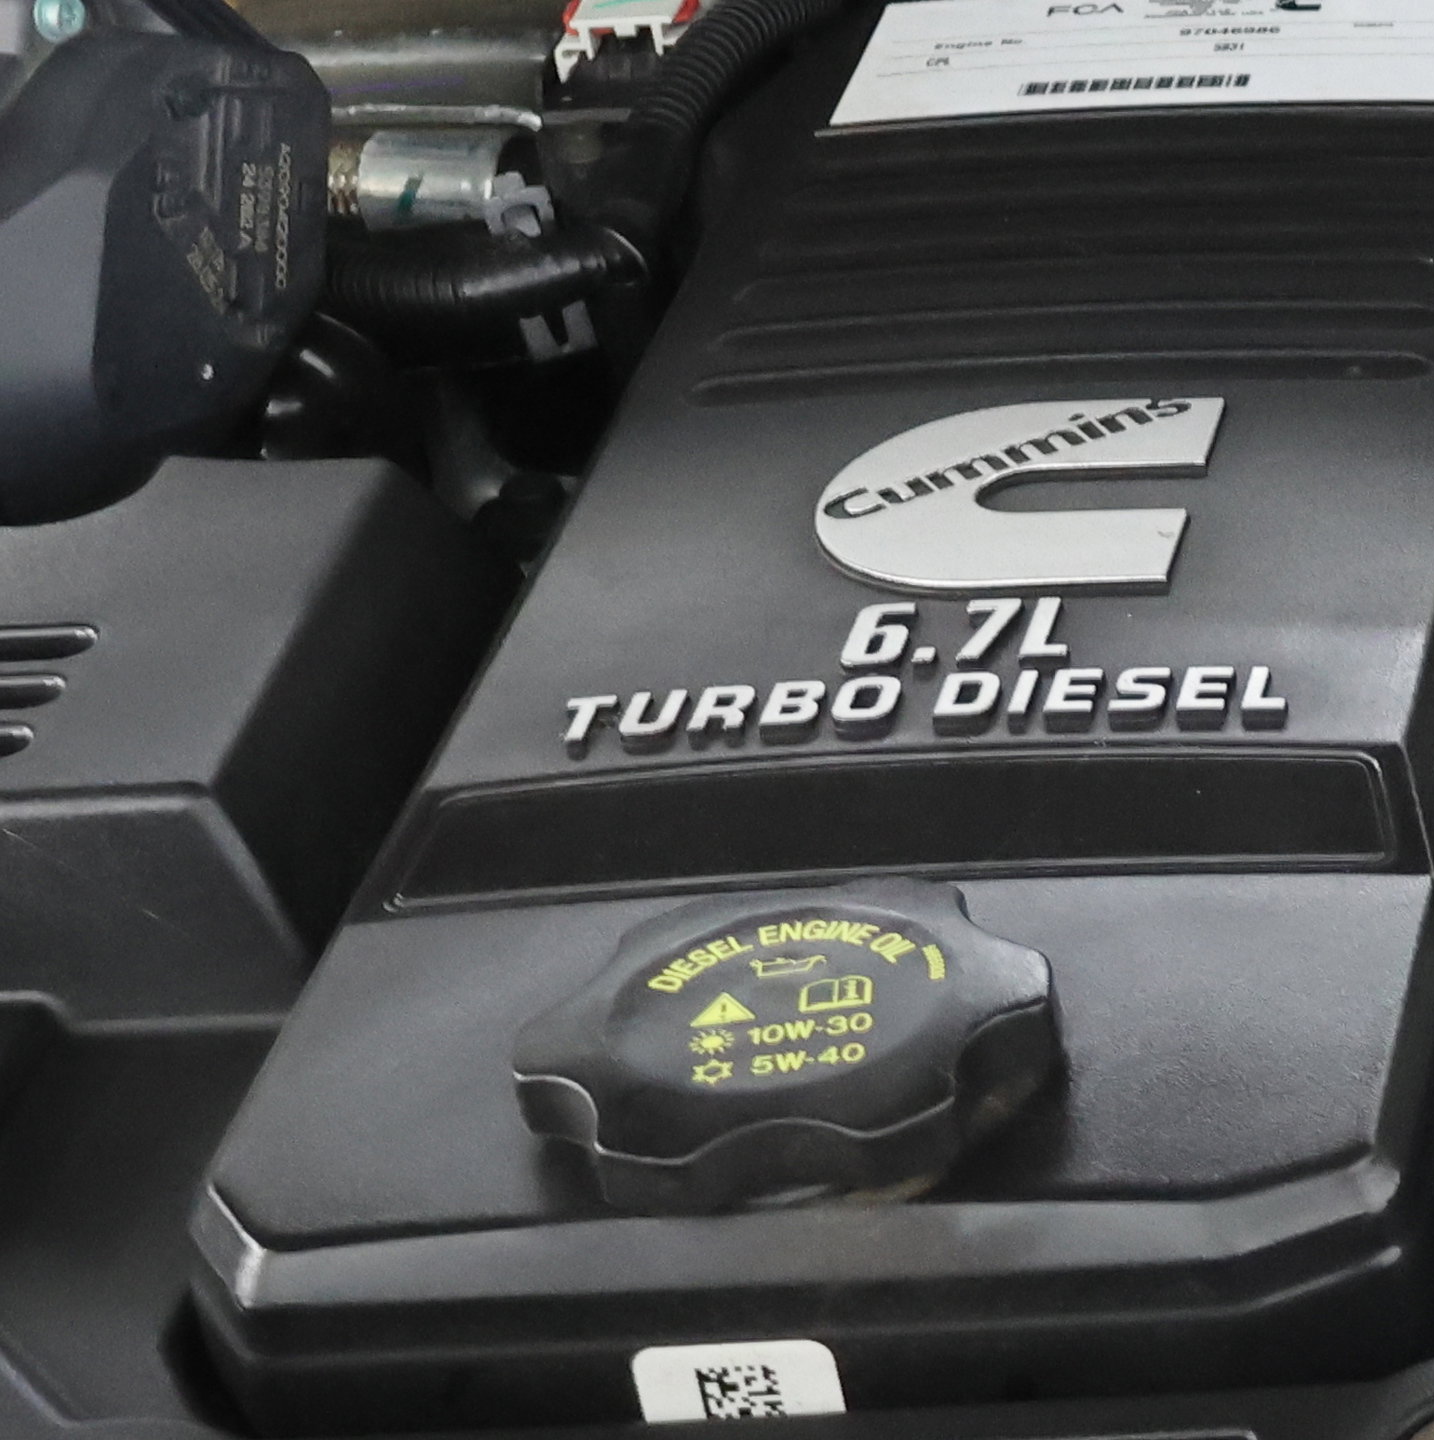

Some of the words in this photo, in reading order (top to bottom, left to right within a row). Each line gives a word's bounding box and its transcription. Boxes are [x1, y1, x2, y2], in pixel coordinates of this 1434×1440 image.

[1046, 1, 1124, 18] FCA
[823, 398, 1194, 520] Cummins
[840, 596, 1071, 673] 6.7L
[562, 673, 902, 757] TURBO
[931, 664, 1291, 732] DIESEL
[647, 935, 754, 994] DIESEL
[758, 920, 881, 947] ENGINE
[869, 932, 917, 965] OIL
[747, 1012, 873, 1046] 10W-30
[751, 1042, 866, 1077] 5W-40
